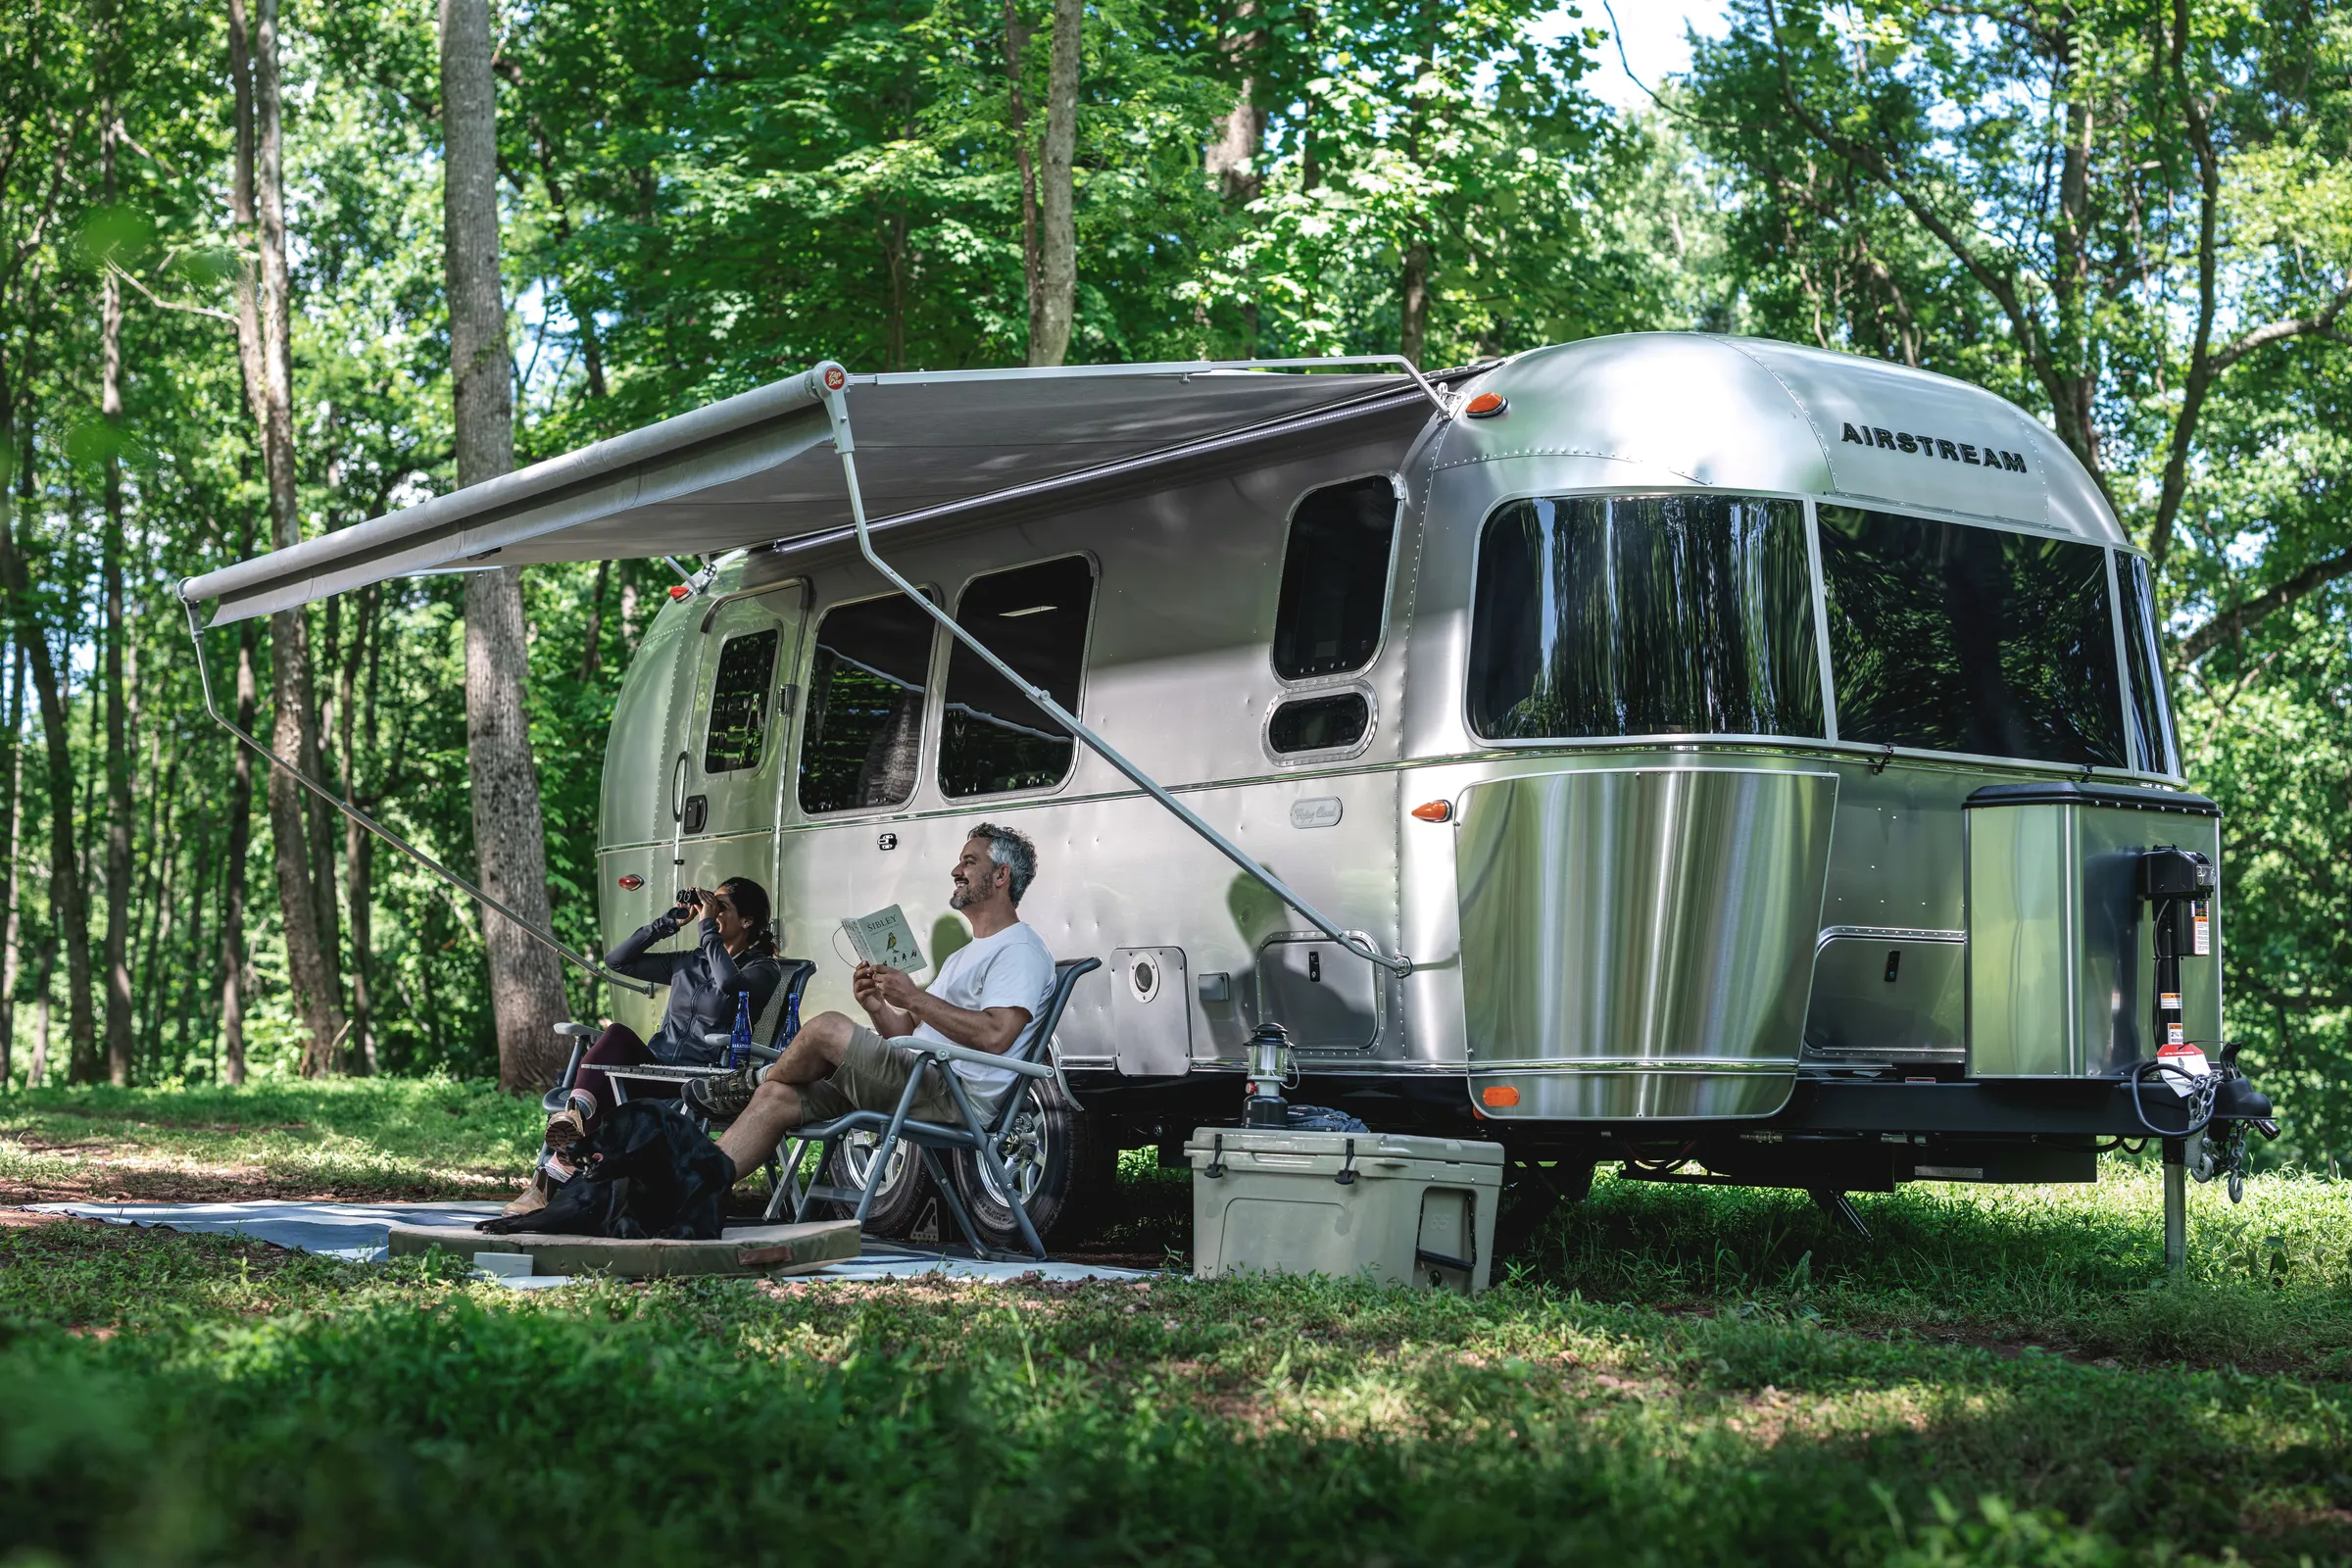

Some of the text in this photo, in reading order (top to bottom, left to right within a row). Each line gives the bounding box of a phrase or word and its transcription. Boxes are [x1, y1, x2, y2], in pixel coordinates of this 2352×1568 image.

[1840, 421, 2028, 473] AIRSTREAM
[866, 914, 898, 932] SIBLEY
[1428, 1213, 1450, 1231] 65
